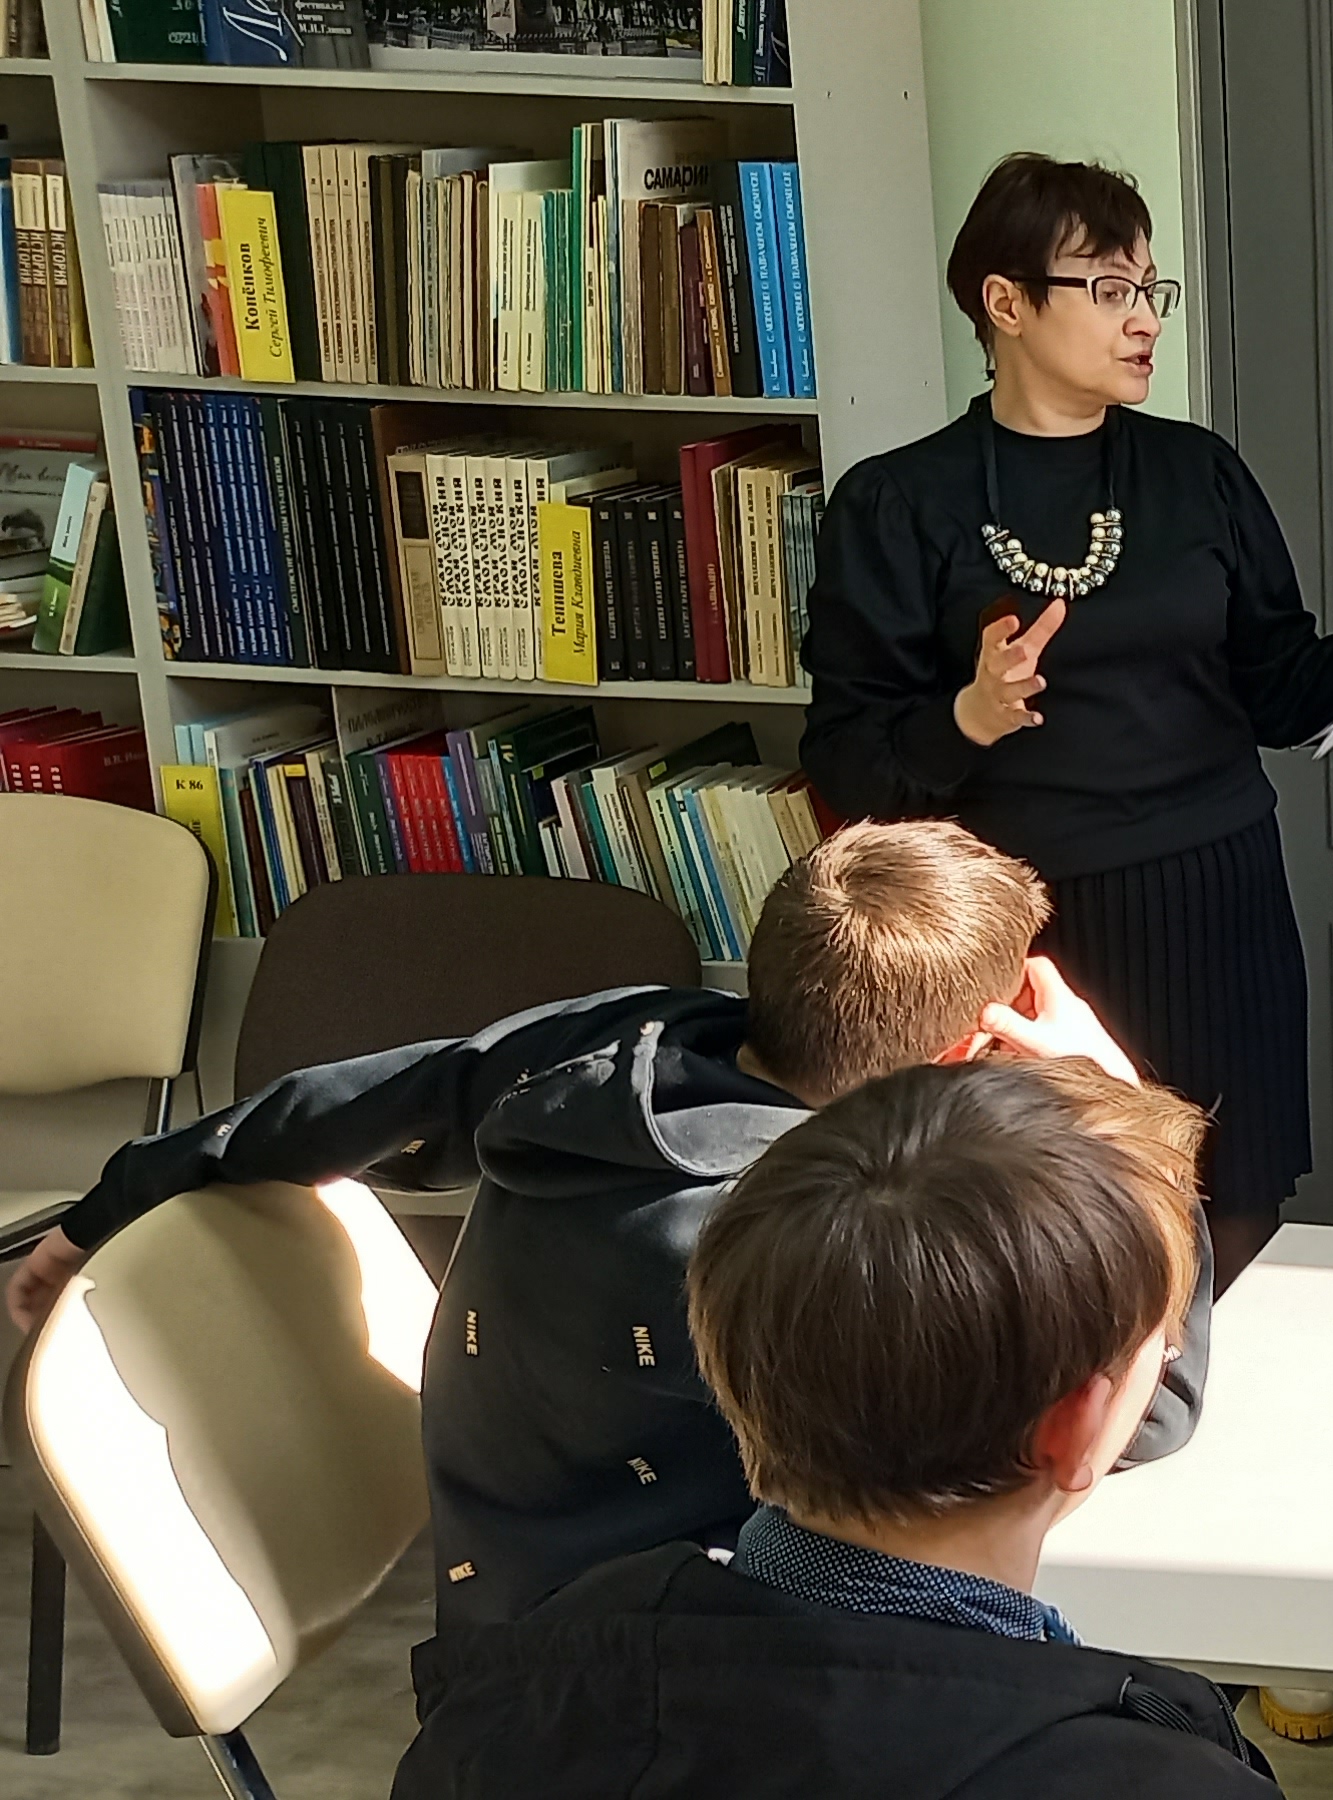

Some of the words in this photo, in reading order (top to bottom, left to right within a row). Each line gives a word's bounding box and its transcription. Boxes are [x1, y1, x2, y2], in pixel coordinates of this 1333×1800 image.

[31, 232, 46, 285] ИСТОРИЯ
[51, 232, 67, 285] ИСТОРИЯ
[257, 217, 277, 304] Тимофеевич
[239, 243, 260, 330] Конёнков
[266, 309, 283, 357] Сергей
[551, 551, 566, 636] Тенишева
[571, 531, 584, 609] Клавдиевна
[573, 613, 588, 655] Мария
[189, 780, 204, 790] 86
[467, 1310, 478, 1356] NIKE
[632, 1325, 655, 1367] NIKE
[627, 1456, 657, 1485] NIKE
[449, 1561, 476, 1583] NIKE
